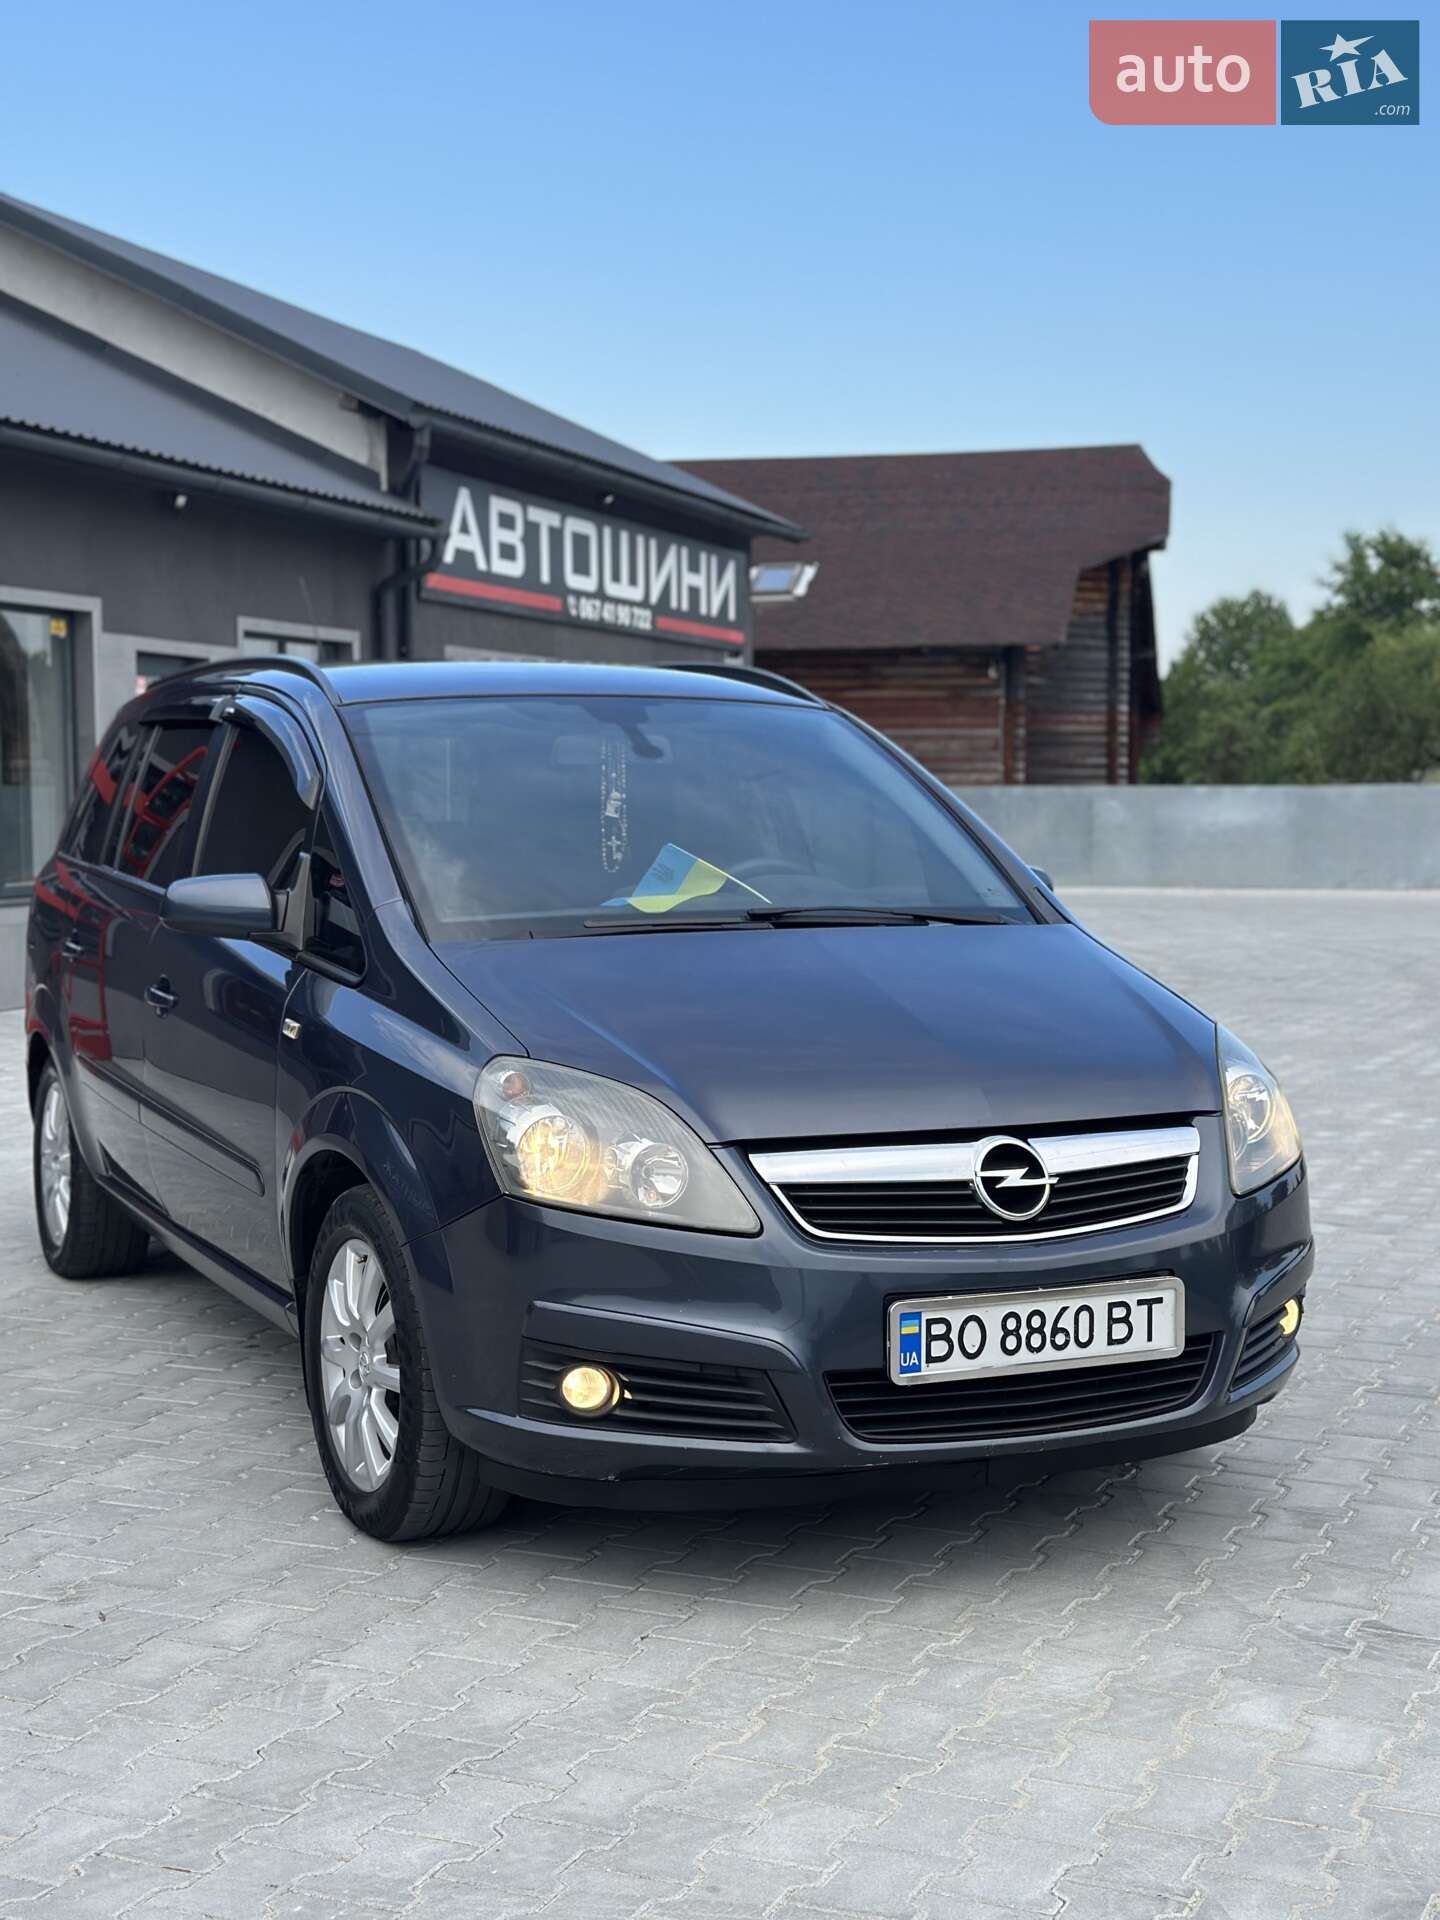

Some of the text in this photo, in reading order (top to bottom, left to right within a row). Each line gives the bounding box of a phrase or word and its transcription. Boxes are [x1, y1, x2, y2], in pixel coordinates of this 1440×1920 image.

[443, 486, 737, 621] АВТОШИНИ
[900, 1352, 919, 1367] UA
[925, 1297, 1164, 1364] BO 8860 BT
